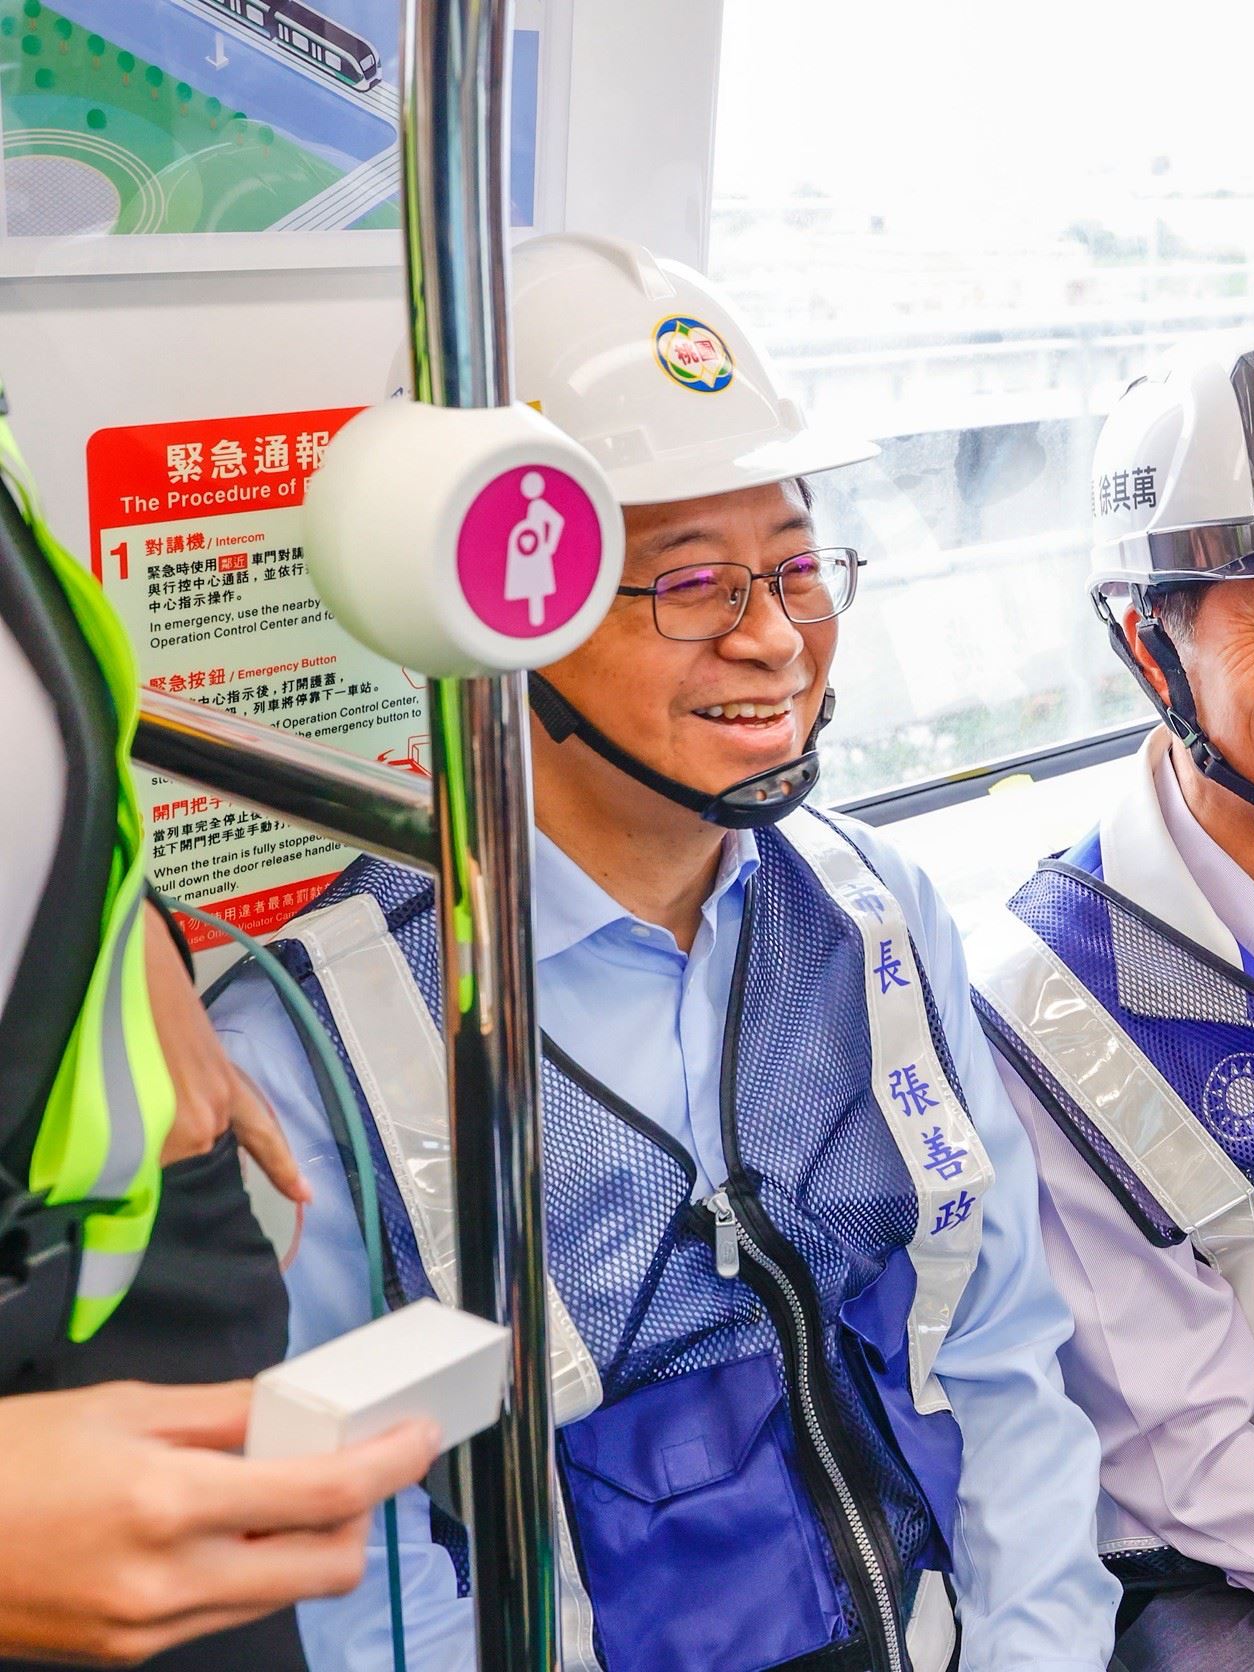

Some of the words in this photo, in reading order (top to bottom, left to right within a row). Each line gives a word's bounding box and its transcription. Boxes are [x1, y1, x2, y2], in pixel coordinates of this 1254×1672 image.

[167, 431, 329, 484] 緊急通報
[120, 496, 160, 514] The
[167, 484, 271, 509] Procedure
[278, 479, 297, 496] of
[1099, 466, 1157, 516] 徐其萬
[110, 542, 129, 580] 1
[145, 532, 206, 556] 對講機
[216, 532, 265, 548] Intercom
[150, 621, 161, 632] In
[165, 611, 235, 631] emergency,
[238, 608, 259, 620] use
[262, 604, 279, 617] the
[282, 598, 322, 613] nearby
[150, 631, 211, 650] Operation
[214, 622, 257, 638] Control
[260, 617, 298, 632] Center
[301, 613, 322, 626] and
[150, 667, 226, 692] 緊急按鈕
[238, 661, 299, 680] Emergency
[301, 655, 337, 669] Button
[282, 711, 337, 731] Operation
[340, 702, 379, 717] Control
[381, 695, 419, 709] Center,
[315, 719, 374, 737] emergency
[376, 711, 409, 725] button
[411, 709, 422, 718] to
[153, 796, 223, 823] 開門把手
[154, 865, 188, 879] When
[191, 859, 209, 872] the
[212, 851, 238, 866] train
[240, 848, 250, 858] is
[252, 841, 276, 857] fully
[179, 873, 210, 887] down
[213, 868, 231, 880] the
[234, 861, 259, 875] door
[261, 851, 302, 870] release
[305, 841, 341, 857] handle
[184, 881, 239, 902] manually.
[844, 884, 911, 994] 市長
[888, 1063, 976, 1236] 張善政
